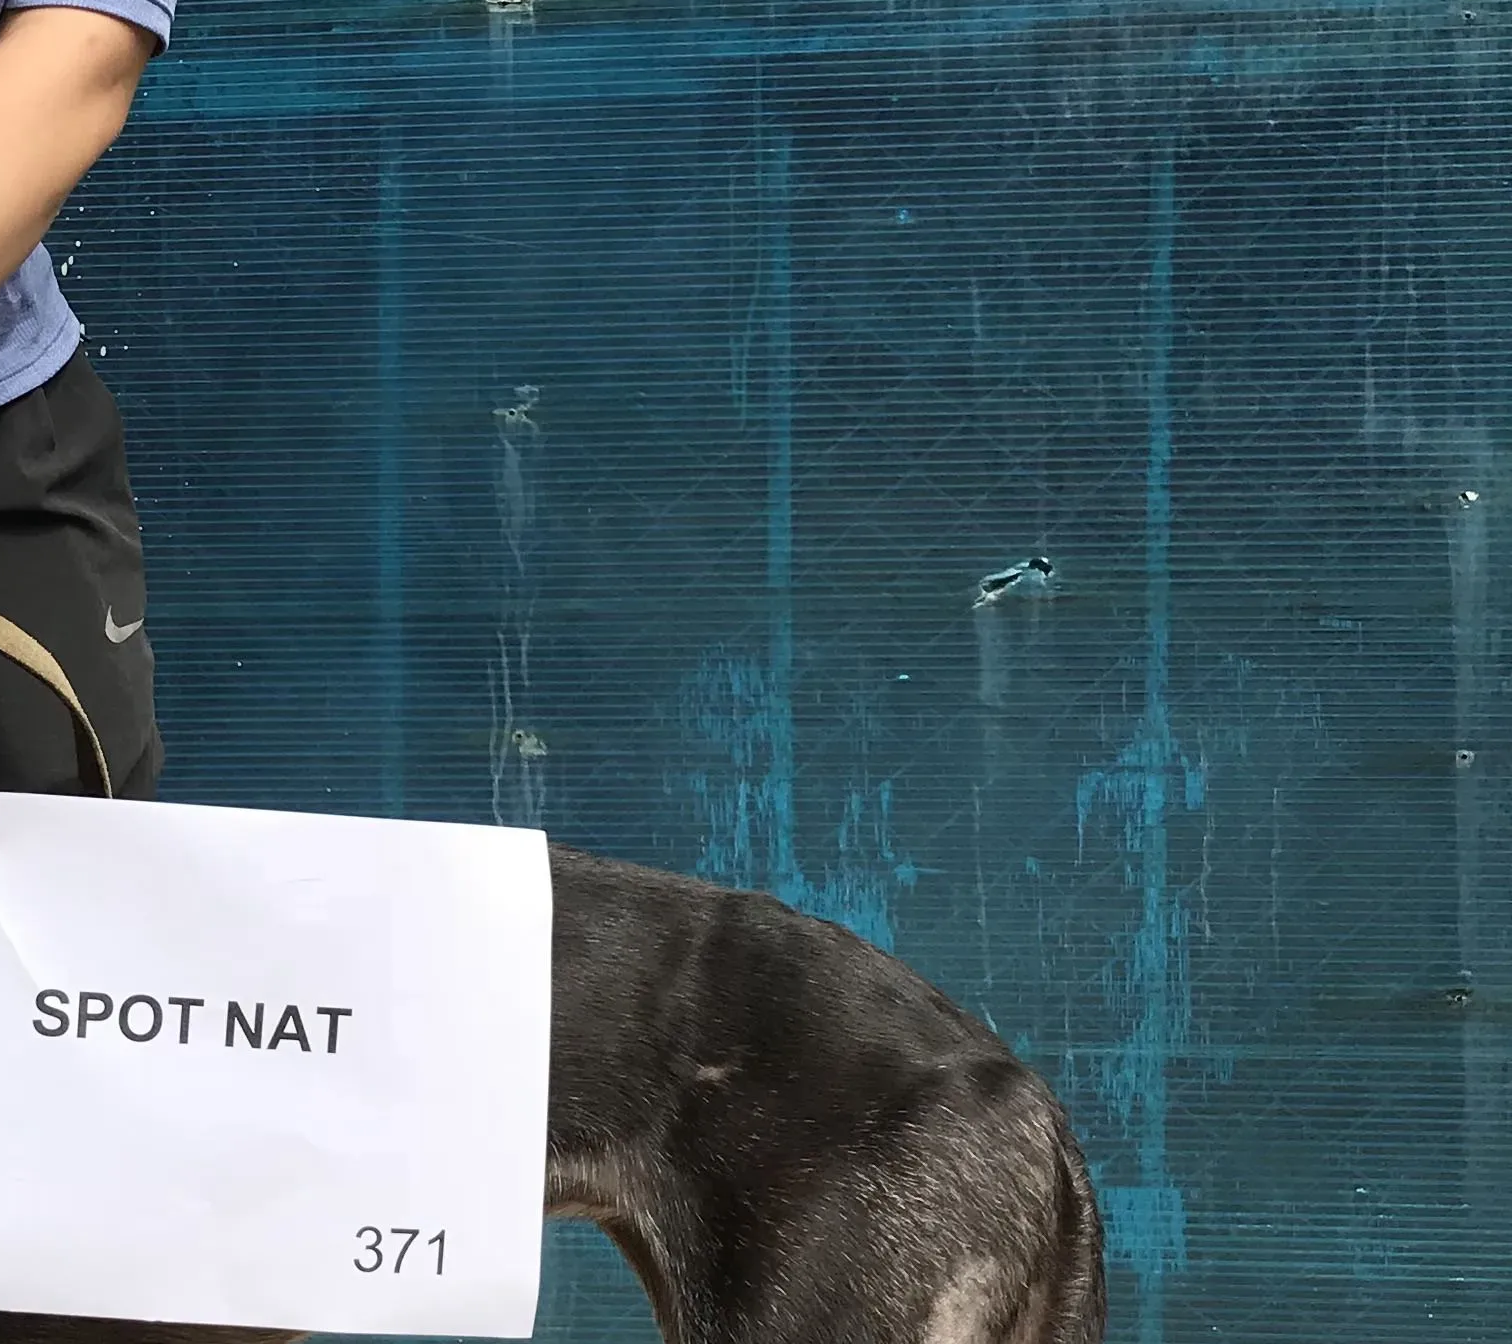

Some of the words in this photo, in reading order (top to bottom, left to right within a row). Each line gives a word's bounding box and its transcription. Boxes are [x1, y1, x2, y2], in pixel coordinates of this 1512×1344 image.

[32, 989, 205, 1044] SPOT
[225, 1001, 353, 1054] NAT
[353, 1226, 446, 1275] 371
